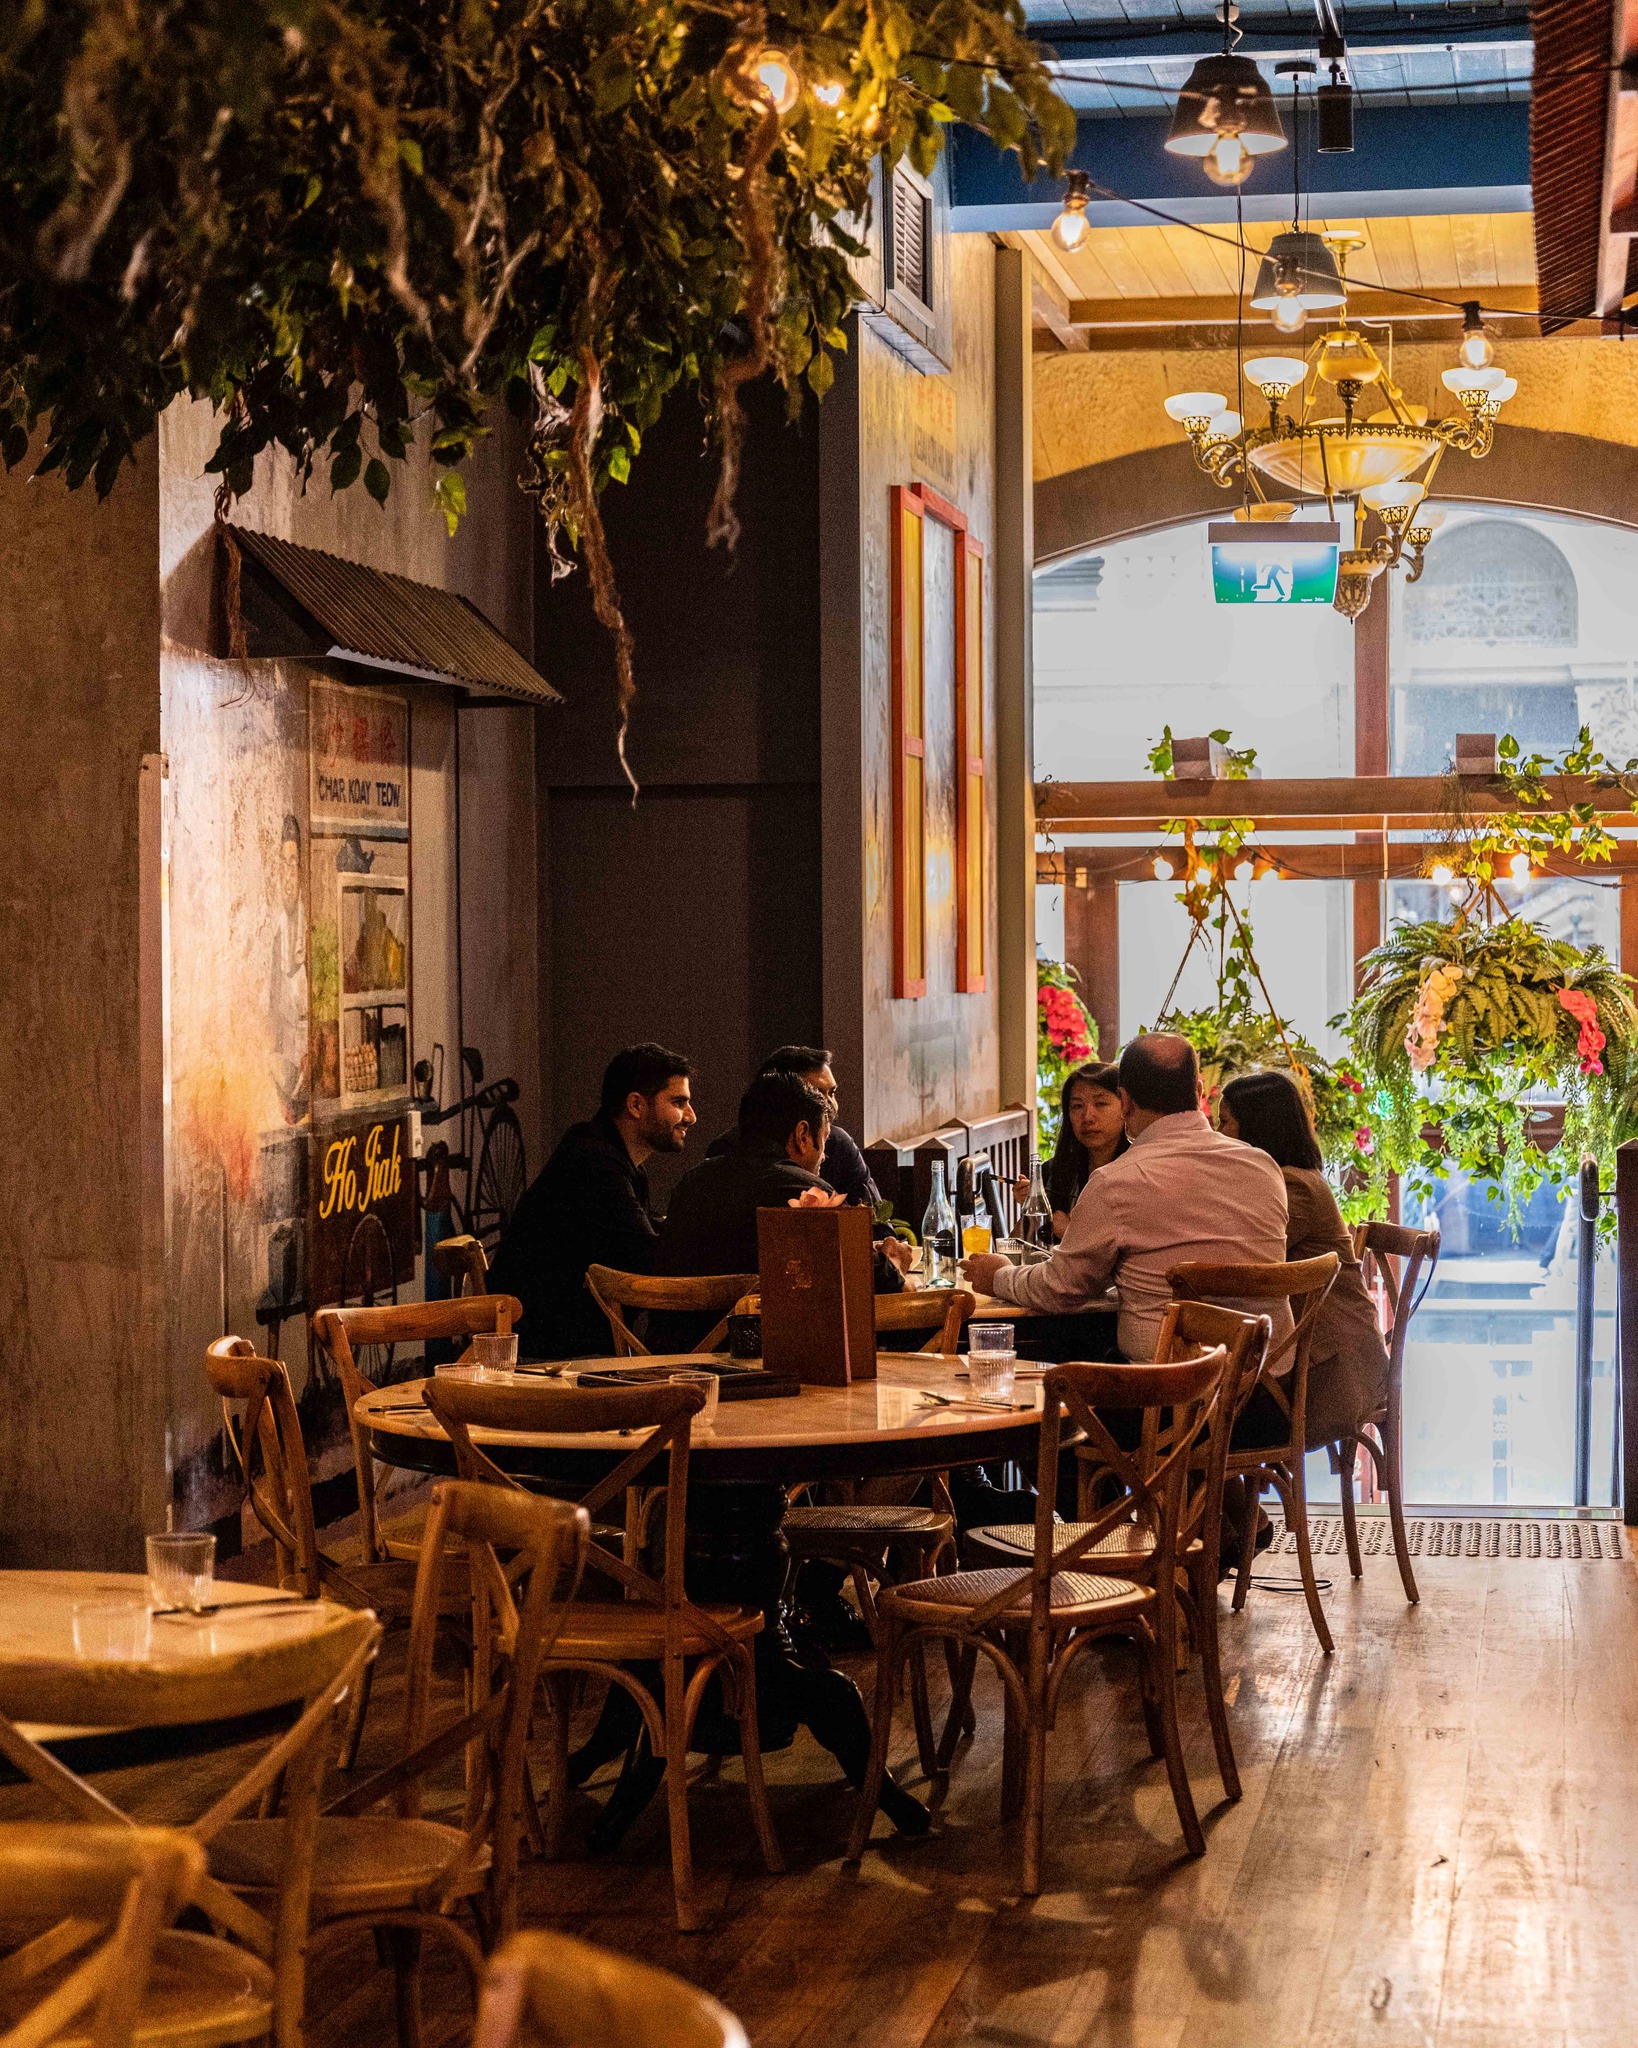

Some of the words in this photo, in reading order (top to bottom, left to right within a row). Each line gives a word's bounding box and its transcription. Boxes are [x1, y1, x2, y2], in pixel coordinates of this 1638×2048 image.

[318, 775, 346, 803] CHAR
[348, 778, 371, 804] KOAY
[376, 782, 401, 807] TEOW
[319, 1135, 357, 1220] Ho
[358, 1124, 402, 1213] Jiak
